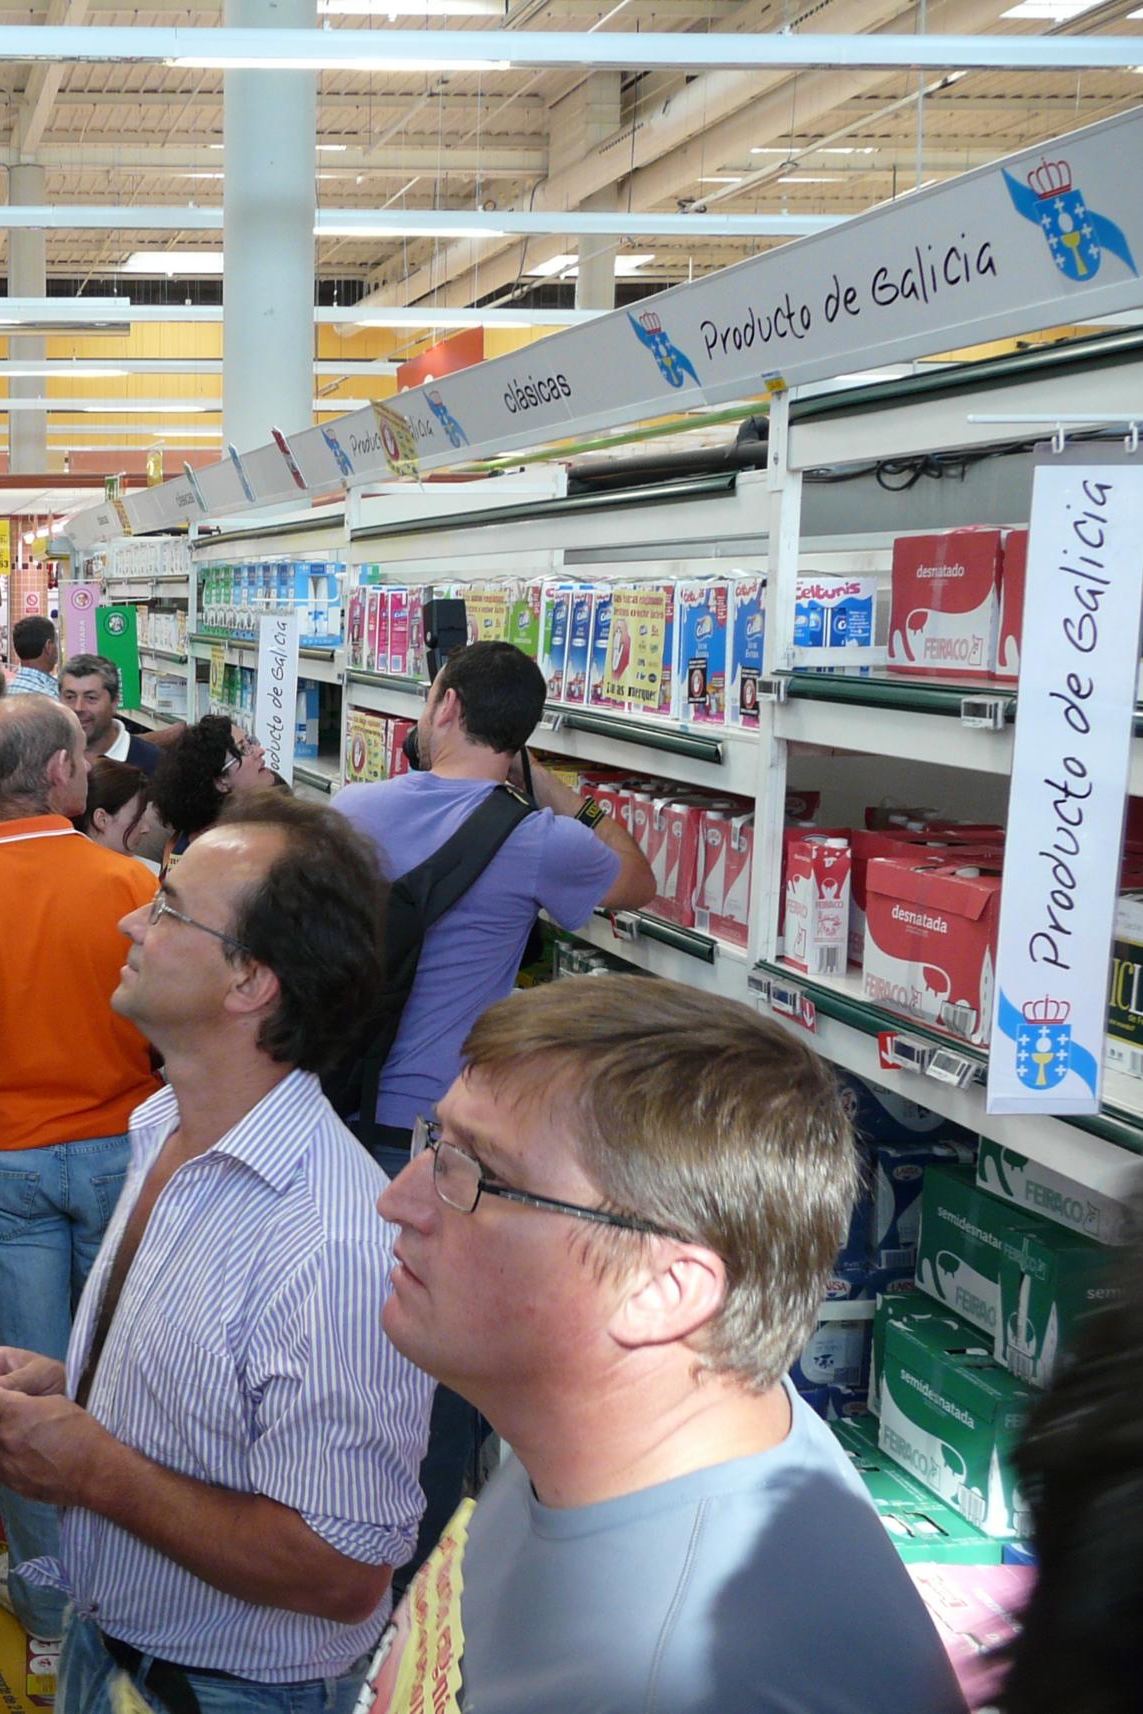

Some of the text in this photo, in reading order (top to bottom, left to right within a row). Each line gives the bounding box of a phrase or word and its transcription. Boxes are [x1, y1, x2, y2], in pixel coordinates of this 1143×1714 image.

[700, 233, 997, 360] Producto de Galicia
[503, 374, 571, 414] clásicas
[349, 431, 381, 457] Produc
[916, 563, 965, 579] desnatado
[924, 637, 969, 661] FEIRACO
[266, 620, 290, 771] oducto de Galicia
[1028, 479, 1113, 970] Producto de Galicia
[891, 904, 948, 934] desnatada
[1024, 1179, 1084, 1224] FEIRACO
[937, 1206, 1003, 1250] semidesnata
[955, 1286, 997, 1328] FEIRAC
[900, 1368, 975, 1430] semidesnatada
[883, 1424, 928, 1476] FEIRACO
